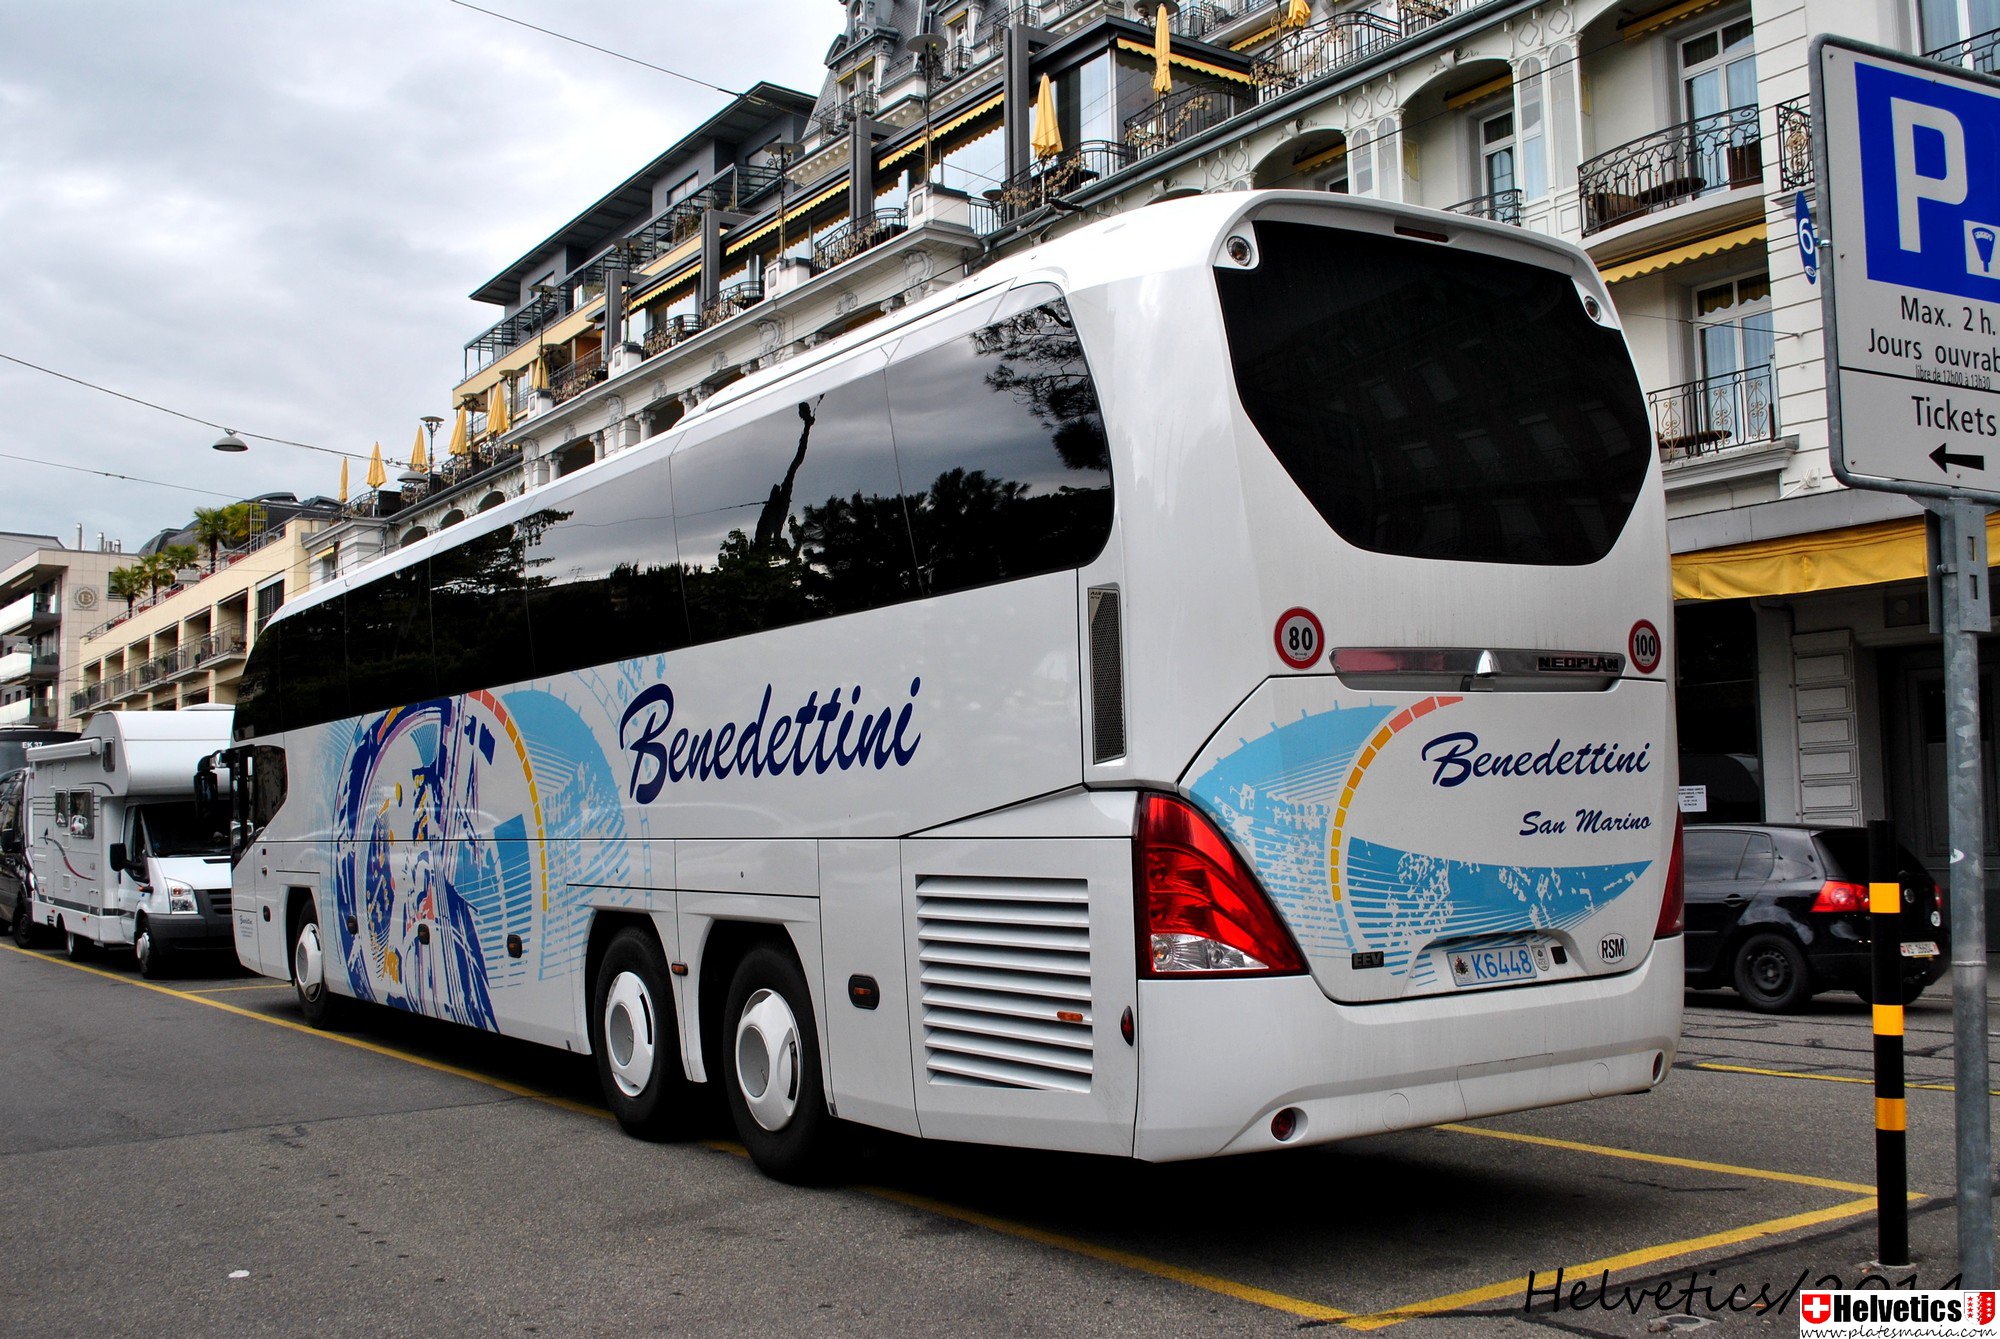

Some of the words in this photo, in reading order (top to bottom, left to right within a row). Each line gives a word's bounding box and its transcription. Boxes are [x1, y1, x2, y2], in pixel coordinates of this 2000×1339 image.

[1890, 96, 1968, 254] P
[1799, 218, 1814, 254] 6
[1901, 295, 1951, 328] Max.
[1962, 306, 1974, 332] 2
[1980, 308, 1996, 336] h.
[1868, 328, 1922, 360] Jours
[1915, 364, 1931, 380] libre
[1932, 367, 1941, 382] de
[1943, 370, 1963, 386] 12h00
[1970, 374, 1991, 390] 13h30
[1911, 395, 1997, 437] Tickets
[1289, 626, 1313, 651] 80
[1635, 634, 1656, 656] 100
[1538, 656, 1619, 672] NEOPLAN
[619, 676, 921, 805] Benedettini
[1421, 731, 1651, 788] Benedettini
[1519, 811, 1566, 836] San
[1576, 808, 1651, 834] Marino
[1354, 953, 1382, 966] EEV
[1601, 938, 1625, 959] RSM
[1471, 949, 1533, 979] K6448
